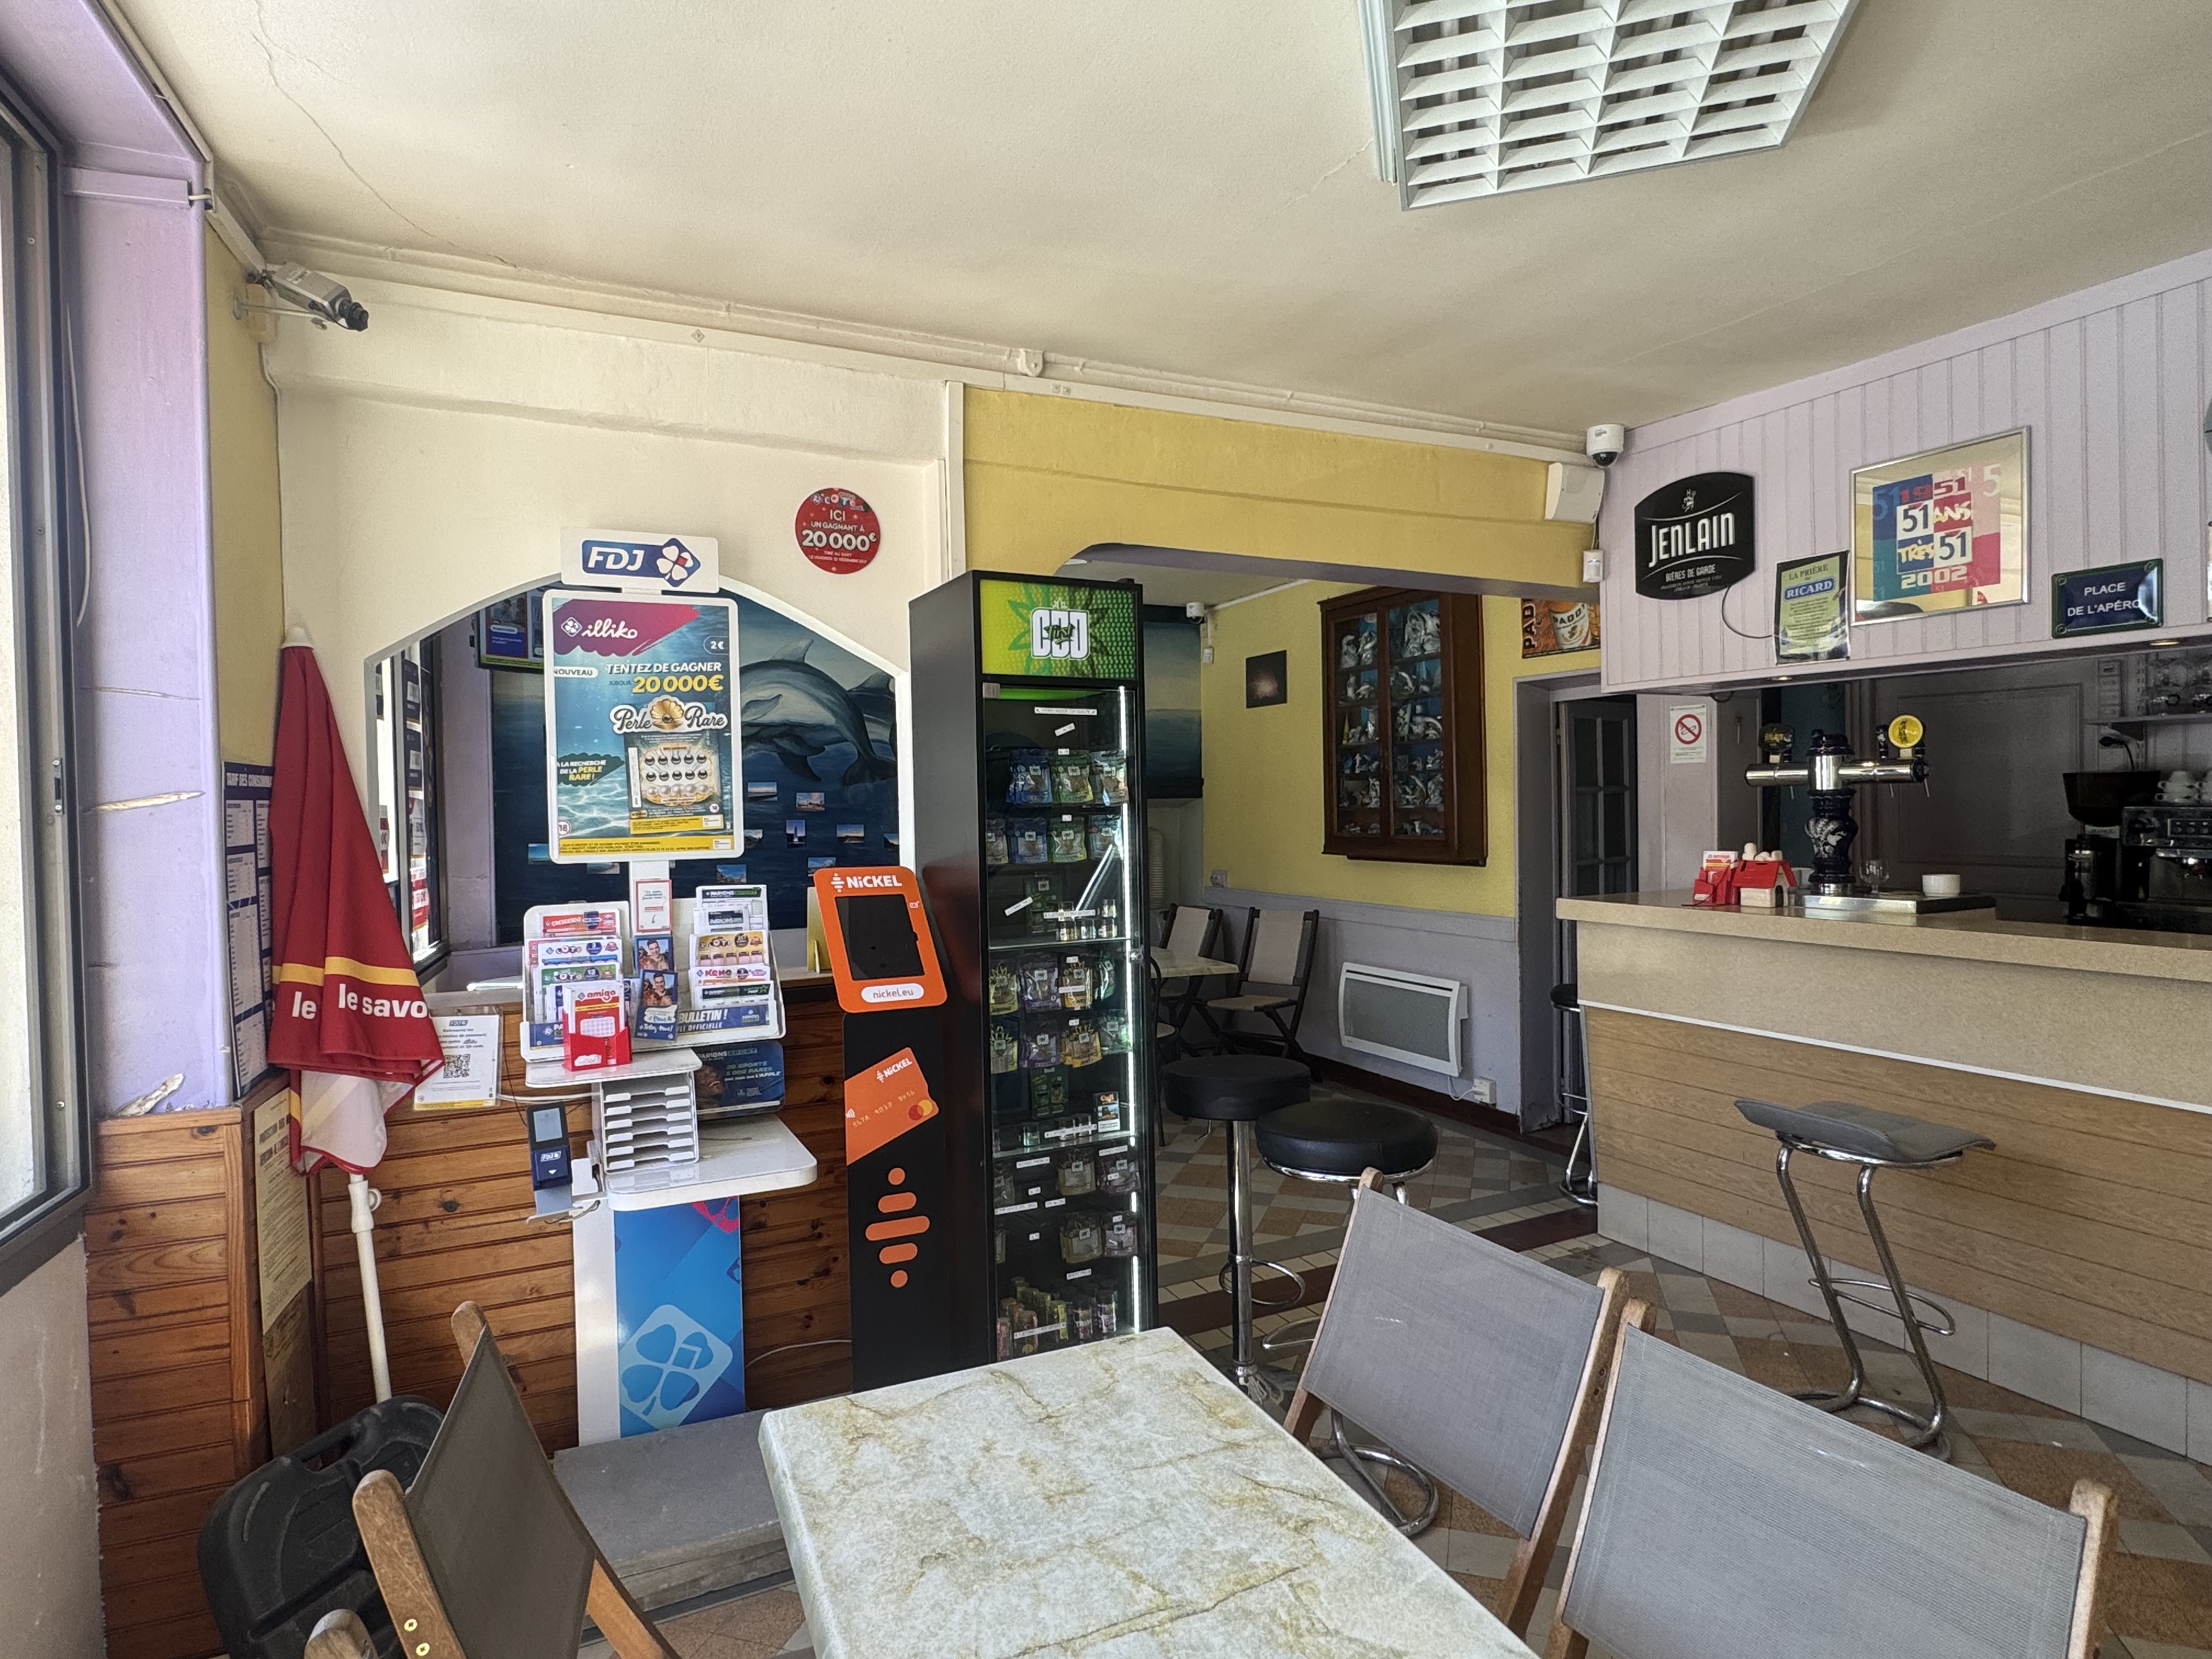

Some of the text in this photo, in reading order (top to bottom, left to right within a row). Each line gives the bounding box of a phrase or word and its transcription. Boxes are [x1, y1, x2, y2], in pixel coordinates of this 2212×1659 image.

[1900, 476, 1966, 504] 1951
[830, 509, 846, 521] ICI
[1902, 504, 1929, 533] 51
[823, 522, 858, 532] GAGNANT
[802, 529, 827, 548] 20
[1648, 512, 1736, 568] JENLAIN
[1939, 532, 1967, 561] 51
[587, 546, 645, 572] FDJ
[1687, 568, 1695, 577] DE
[1696, 564, 1717, 576] GARDE
[1901, 565, 1968, 589] 2002
[1786, 580, 1833, 598] RICARD
[2084, 582, 2126, 596] PLACE
[2067, 606, 2085, 617] DE
[581, 618, 638, 639] illiko
[1032, 609, 1090, 659] CBD
[606, 662, 722, 674] TENTEZ DE GAGNER
[632, 675, 662, 693] 20
[613, 705, 725, 731] Perle Rare
[338, 983, 428, 1018] le savo
[586, 989, 617, 1001] amigo
[872, 988, 914, 999] nickel.eu
[291, 991, 317, 1020] le
[679, 1009, 723, 1024] BULLETIN
[687, 1021, 723, 1031] OFFICIELLE
[737, 1061, 768, 1069] SPORTS
